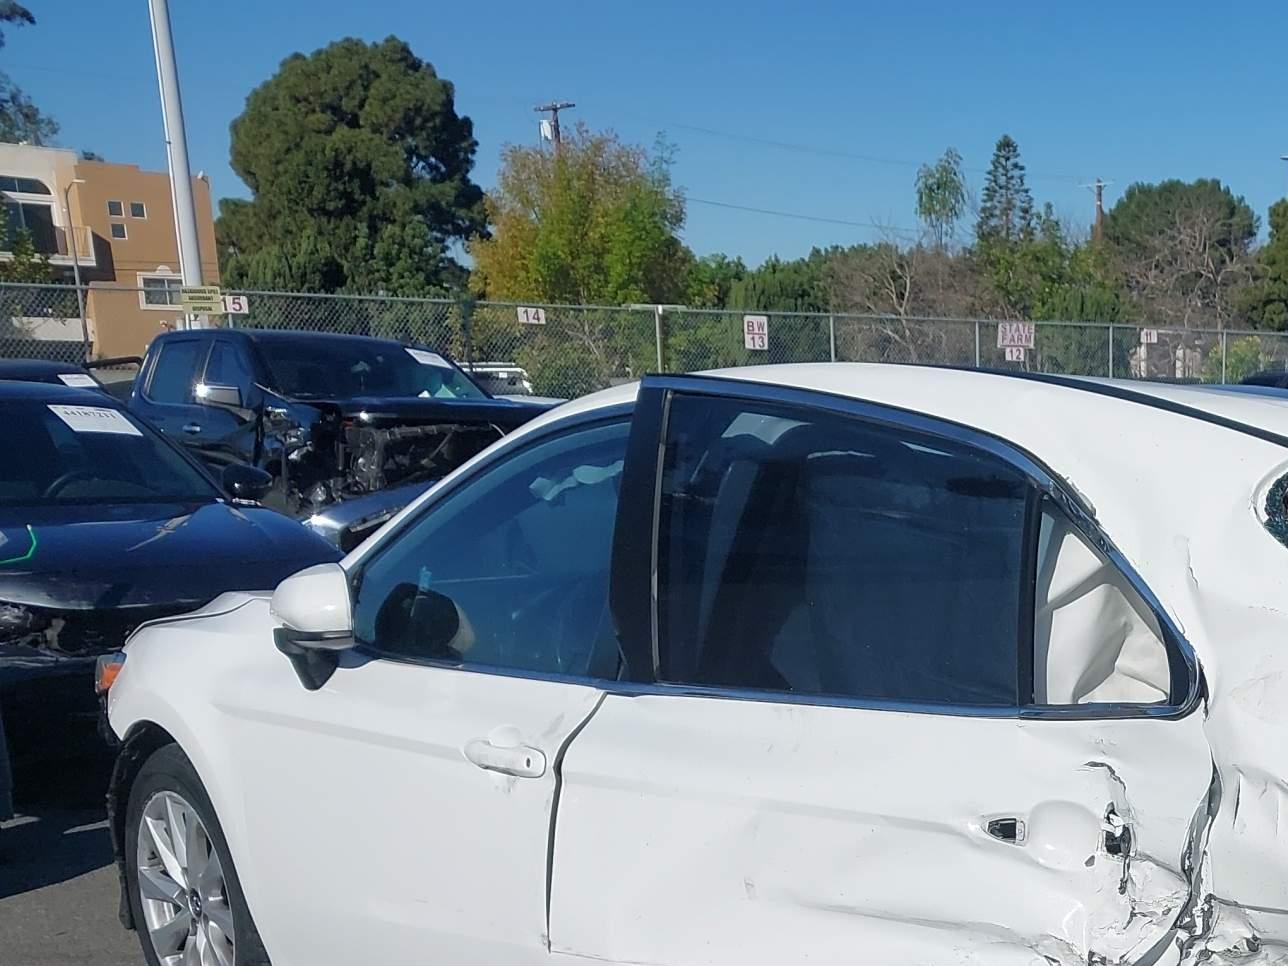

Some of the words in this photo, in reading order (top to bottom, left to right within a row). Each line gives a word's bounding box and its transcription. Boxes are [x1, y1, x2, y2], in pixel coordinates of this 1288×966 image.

[221, 296, 243, 312] 15
[523, 308, 541, 322] 14
[746, 320, 765, 332] BW
[1000, 322, 1034, 334] STATE
[750, 335, 765, 348] 13
[1001, 335, 1032, 345] FARM
[1009, 348, 1022, 360] 12
